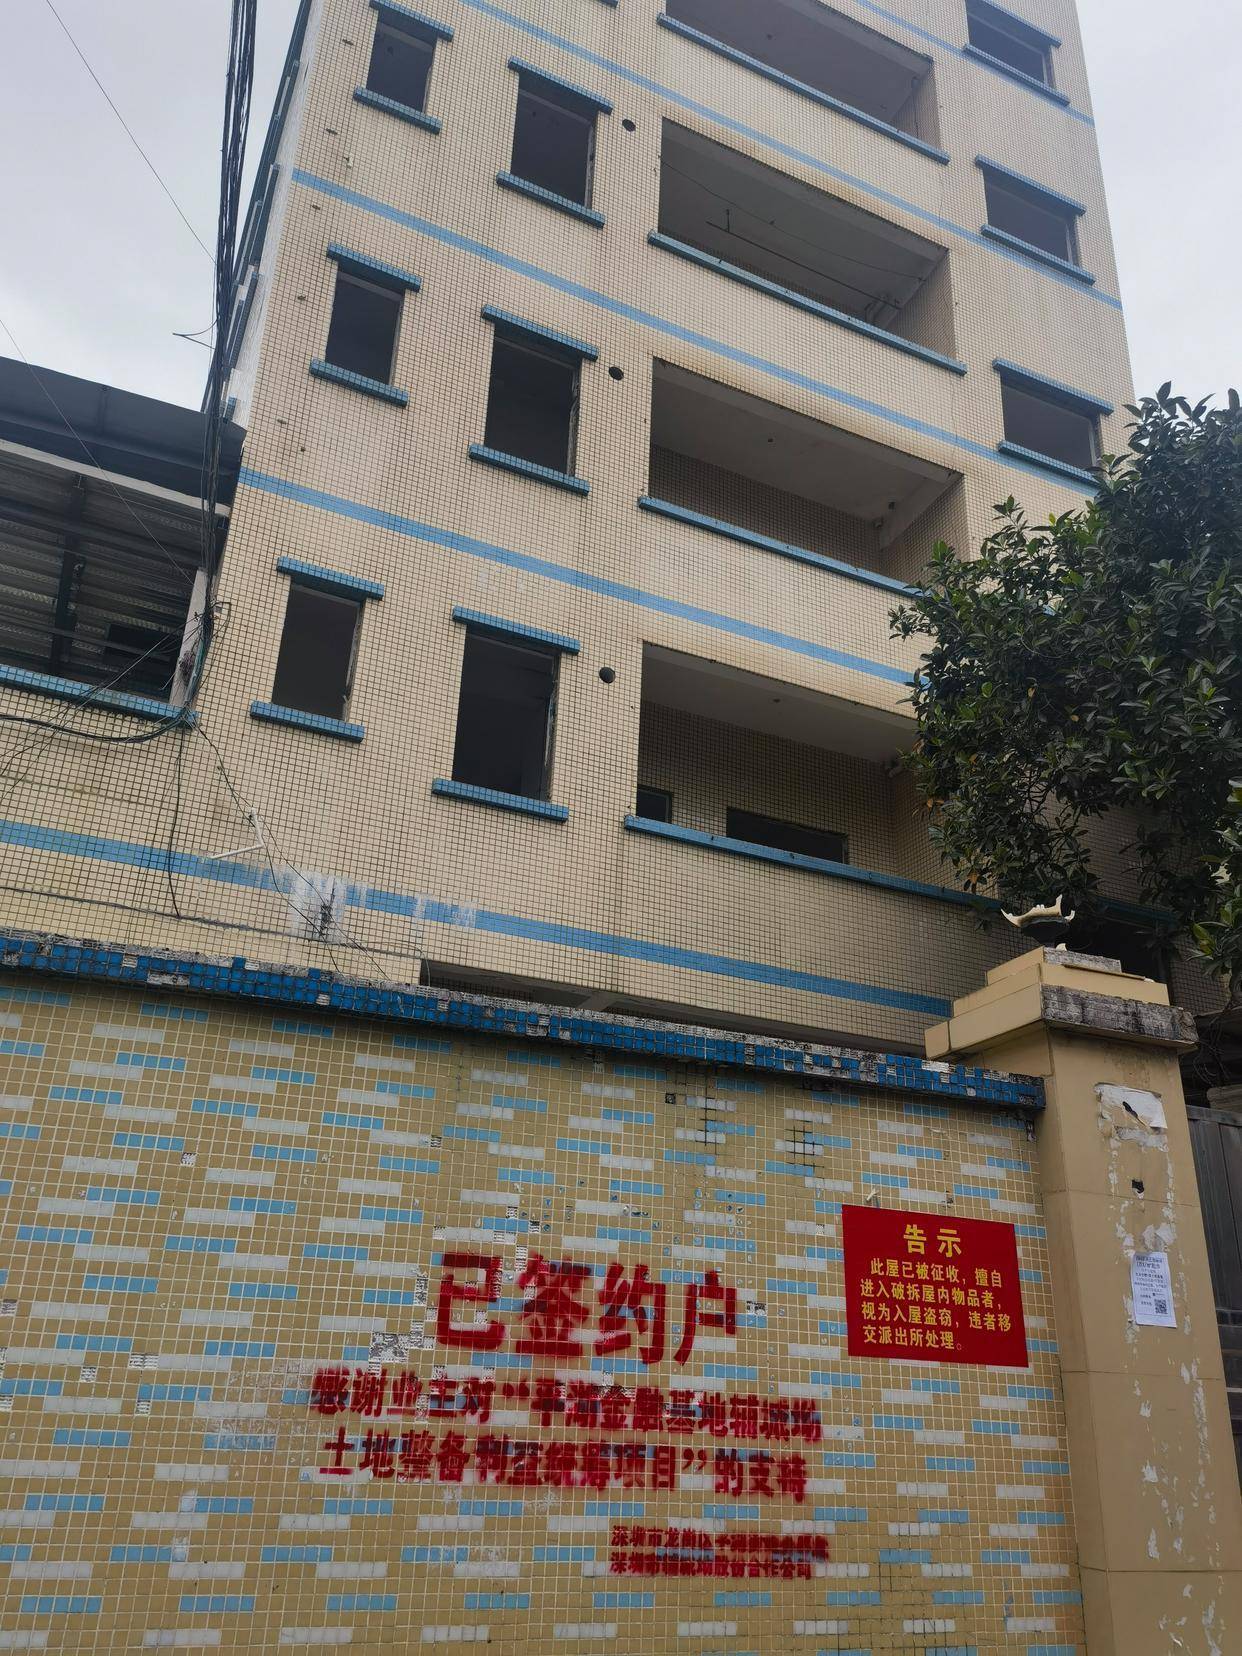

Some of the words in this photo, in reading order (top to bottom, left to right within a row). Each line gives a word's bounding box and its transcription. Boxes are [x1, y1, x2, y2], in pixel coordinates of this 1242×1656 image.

[903, 1223, 962, 1258] 告示
[870, 1257, 1003, 1289] 此屋已被征收，擅自
[436, 1250, 737, 1366] 已签约户
[860, 1278, 1002, 1310] 进入破拆屋内物品者，
[861, 1301, 1012, 1333] 视为入屋盗窃，违者移
[862, 1325, 963, 1351] 交派出所处理。
